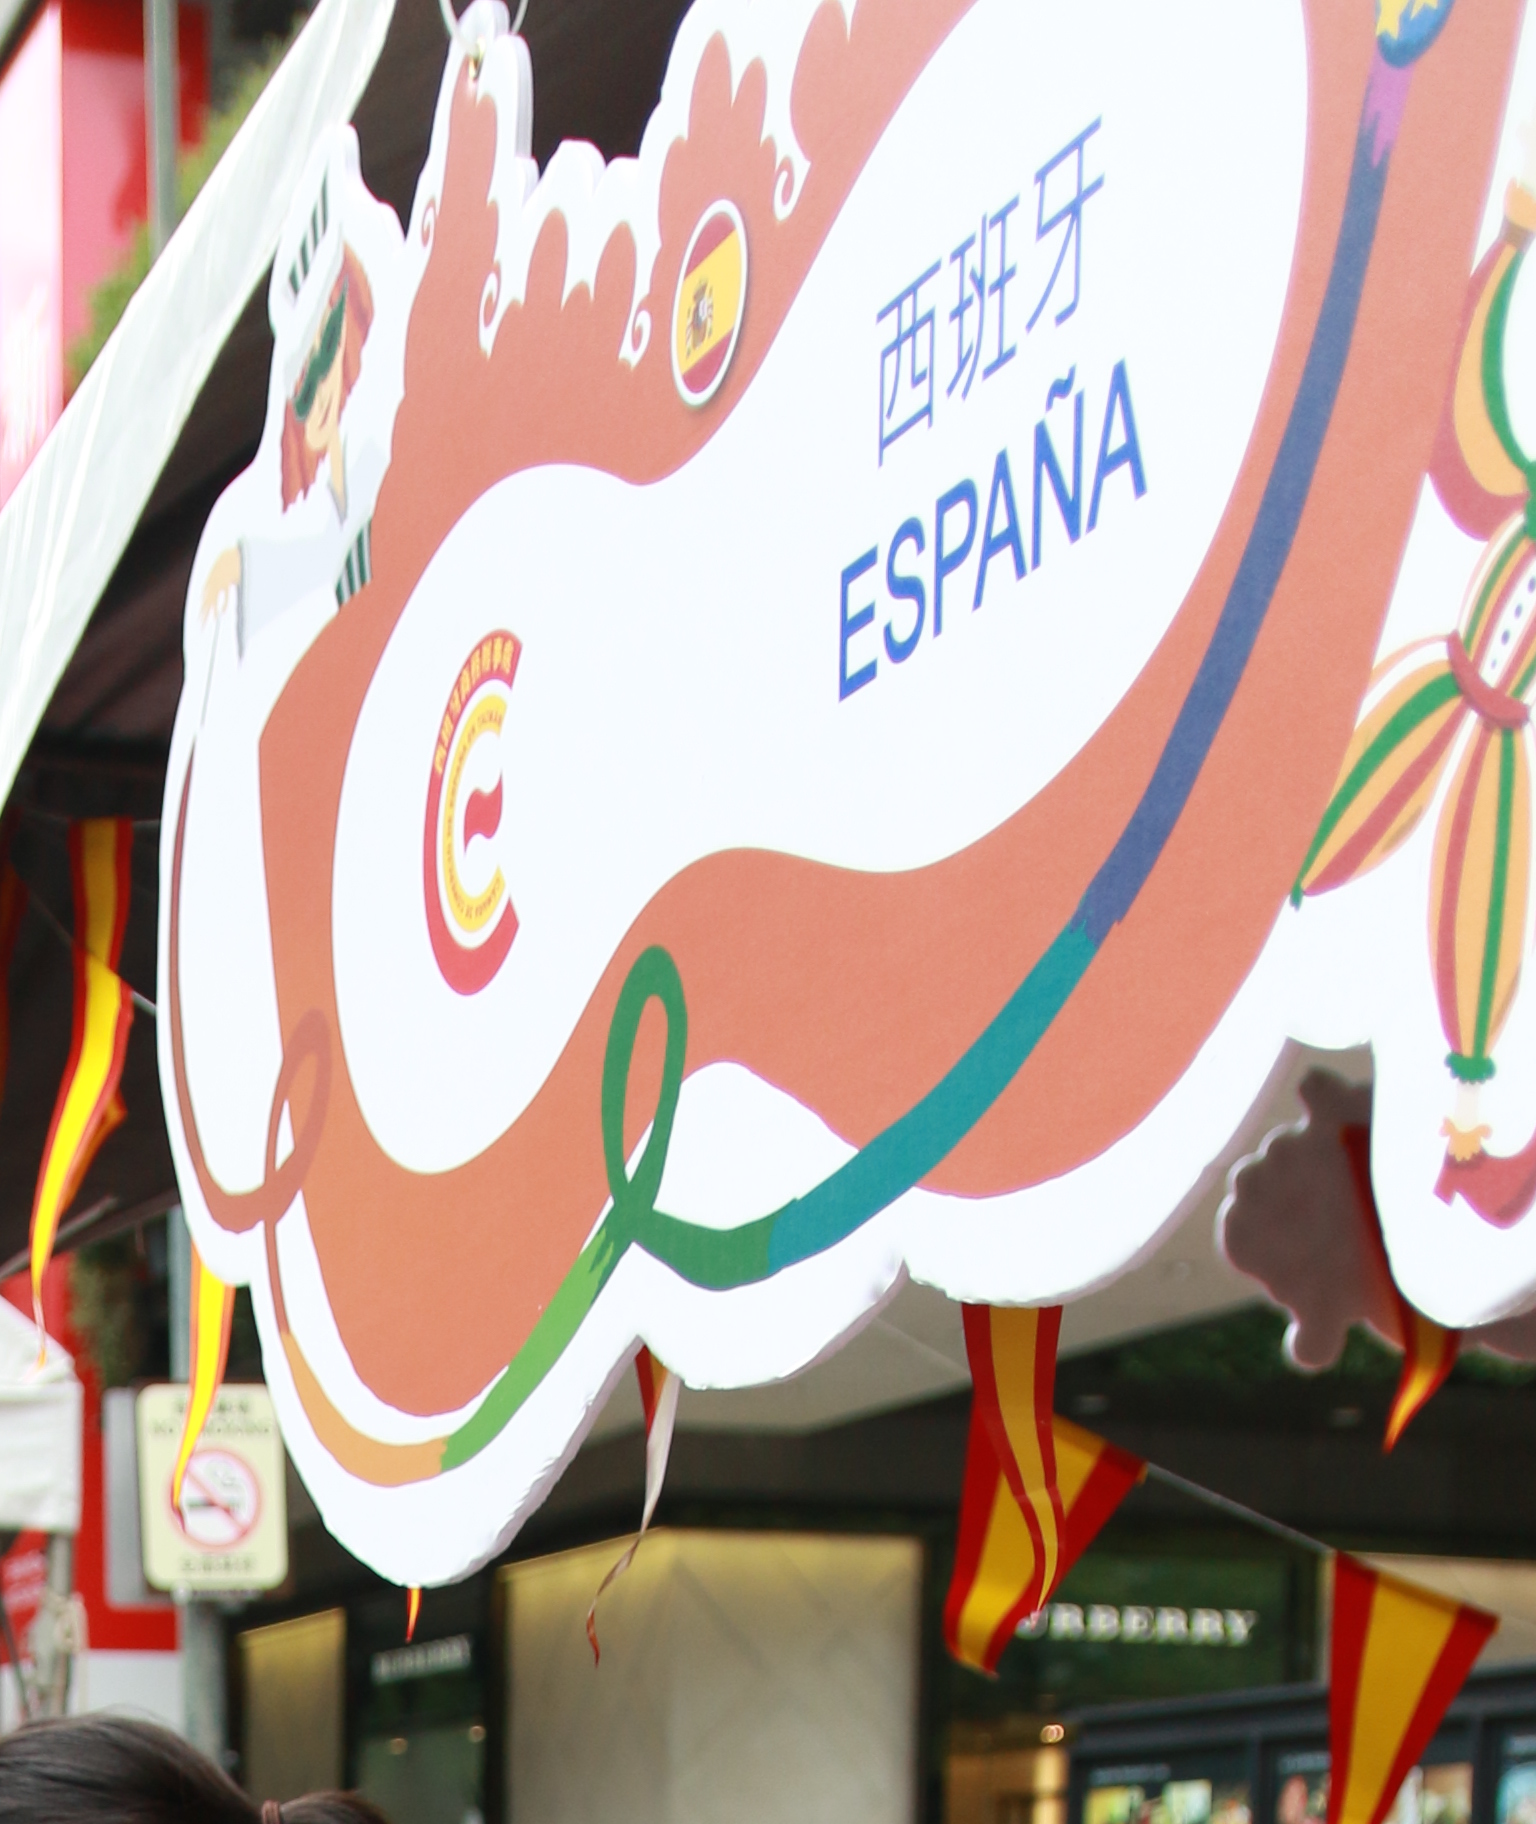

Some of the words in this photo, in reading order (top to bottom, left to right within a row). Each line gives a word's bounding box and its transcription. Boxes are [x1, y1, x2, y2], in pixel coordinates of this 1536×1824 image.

[876, 114, 1105, 468] 西班牙
[838, 358, 1148, 703] ESPAÑA
[1015, 1602, 1259, 1647] URBERRY
